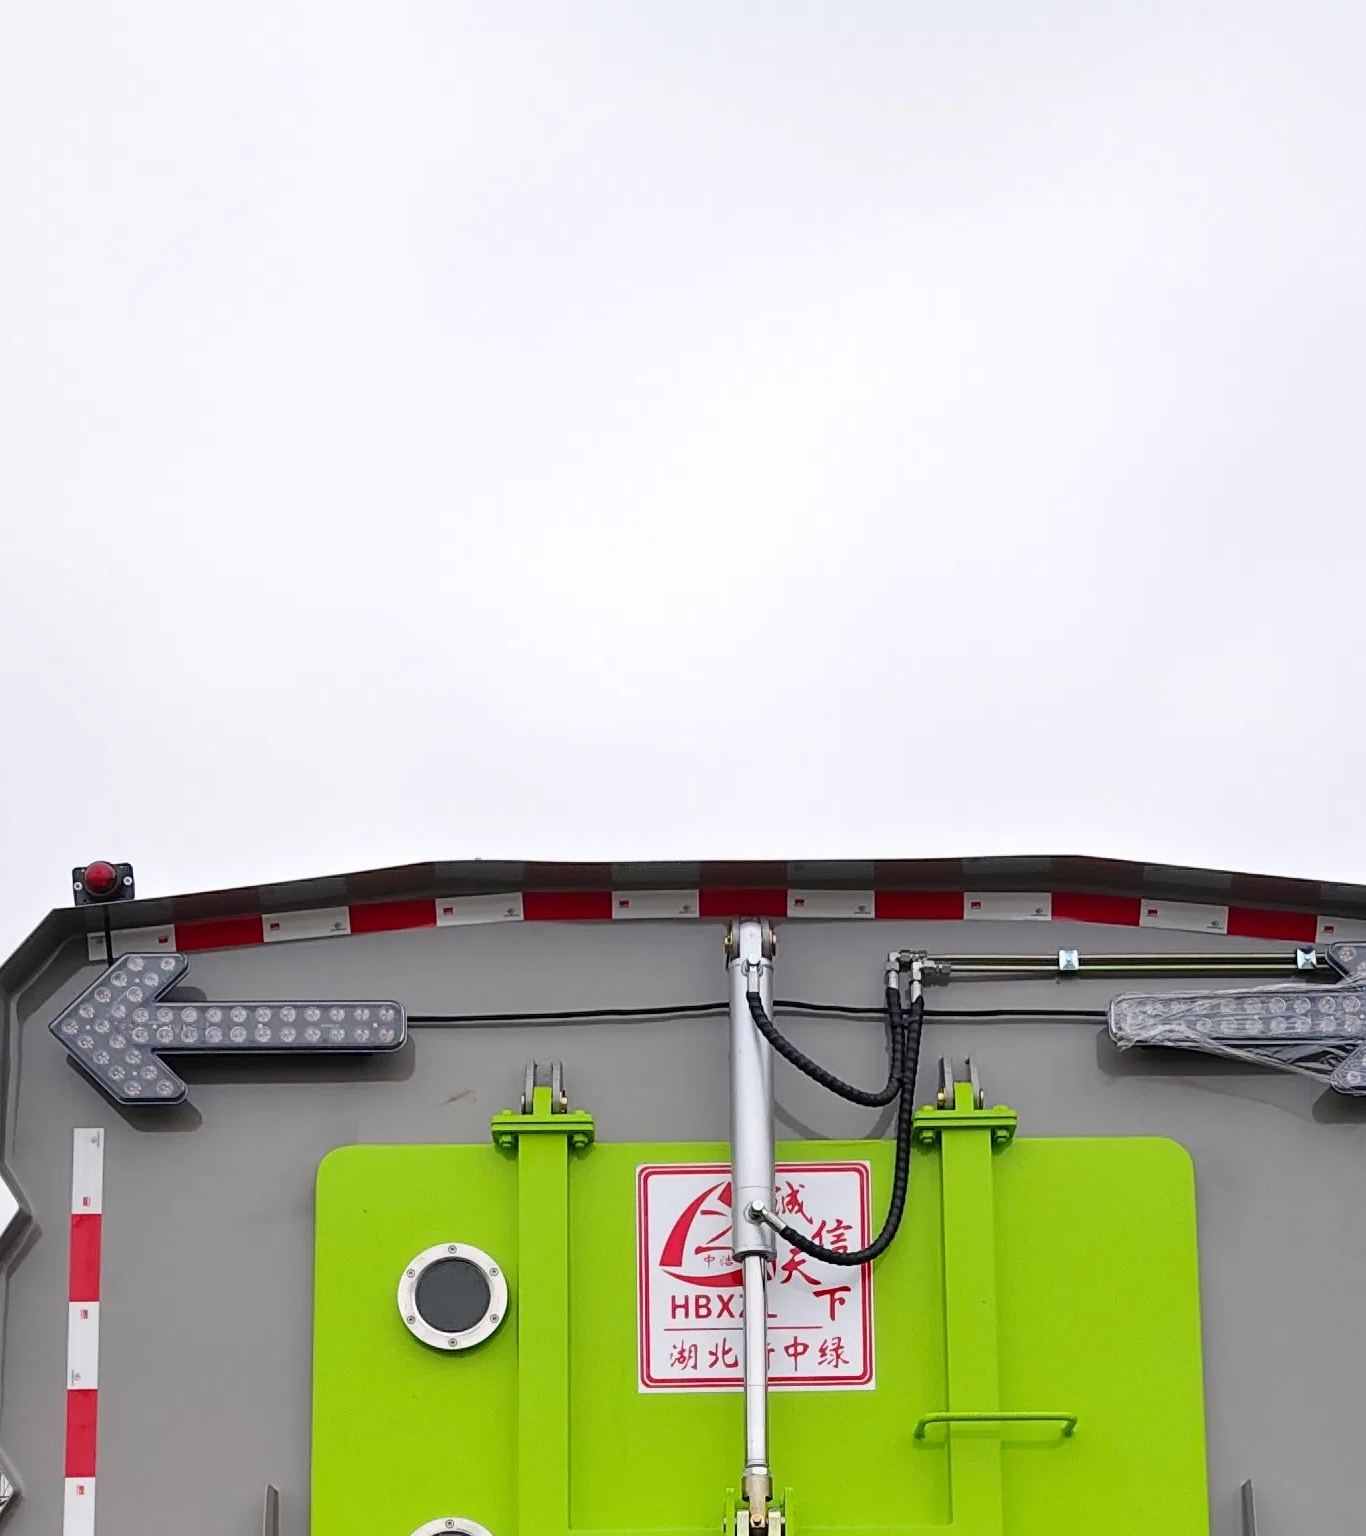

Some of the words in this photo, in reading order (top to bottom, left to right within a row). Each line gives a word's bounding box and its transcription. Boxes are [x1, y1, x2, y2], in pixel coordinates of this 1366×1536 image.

[670, 1293, 778, 1319] HBX
[669, 1335, 850, 1372] 湖北中绿
